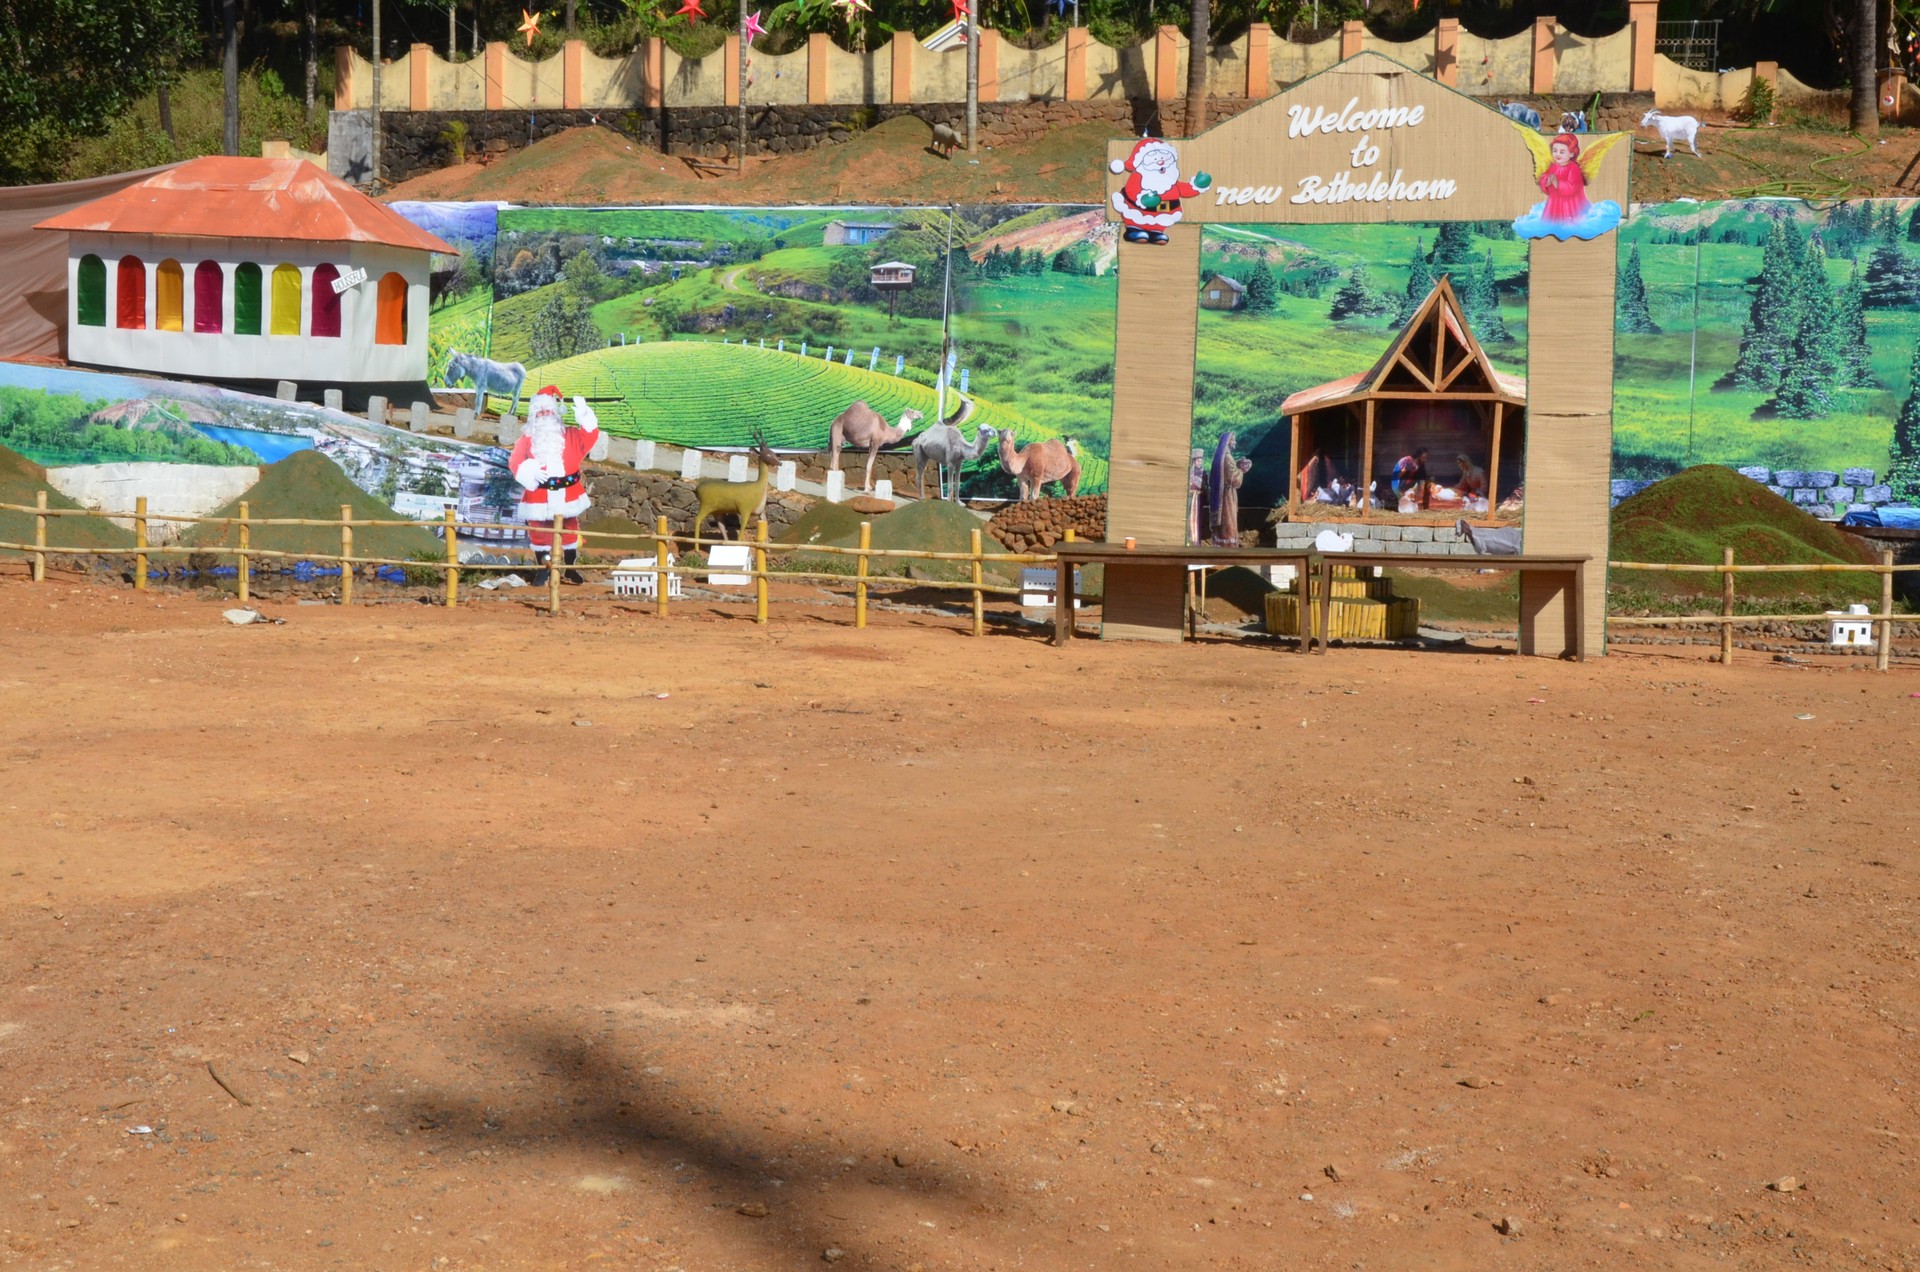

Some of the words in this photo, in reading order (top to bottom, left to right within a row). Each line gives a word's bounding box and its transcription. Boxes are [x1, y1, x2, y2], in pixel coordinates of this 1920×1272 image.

[1287, 97, 1425, 139] Welcome
[1351, 134, 1380, 168] to
[1216, 186, 1283, 206] new
[1291, 169, 1457, 205] Betheleham
